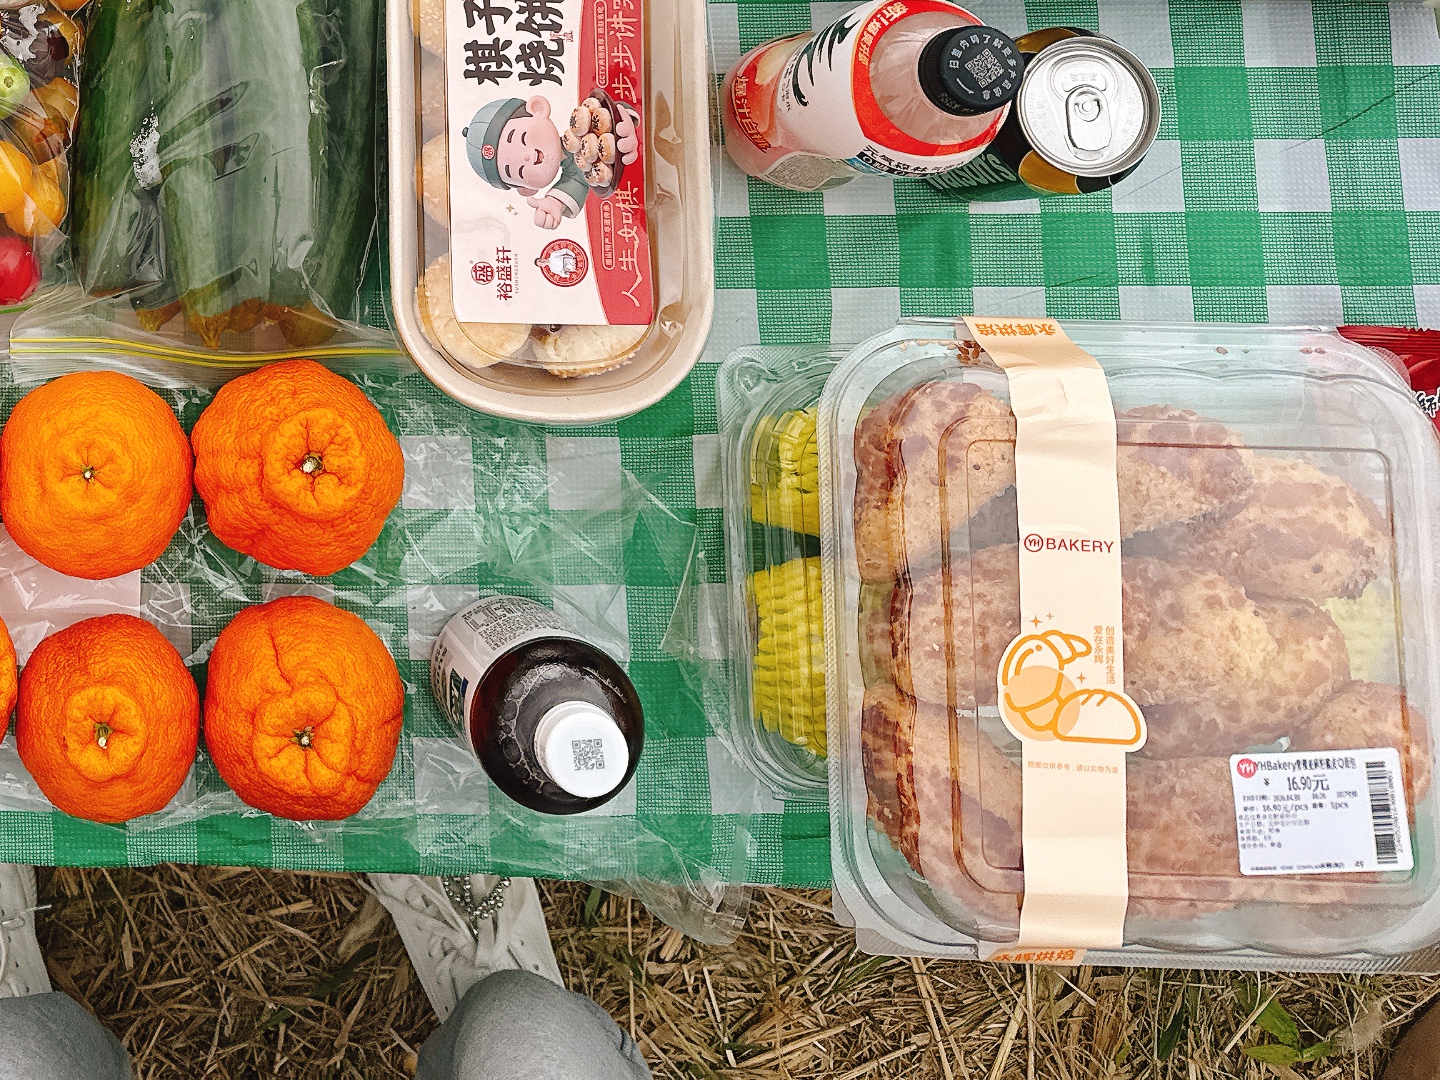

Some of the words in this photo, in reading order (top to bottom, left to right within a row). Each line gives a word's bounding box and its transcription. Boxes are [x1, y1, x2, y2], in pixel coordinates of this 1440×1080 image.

[615, 180, 644, 308] 人生如棋
[495, 246, 512, 301] 裕盛轩
[974, 323, 1057, 337] 永辉烘焙
[1046, 537, 1115, 554] BAKERY
[1093, 625, 1104, 664] 爱在永辉
[1105, 625, 1116, 685] 创造美好生活
[1238, 762, 1256, 775] YH
[1287, 773, 1330, 792] 16.90元
